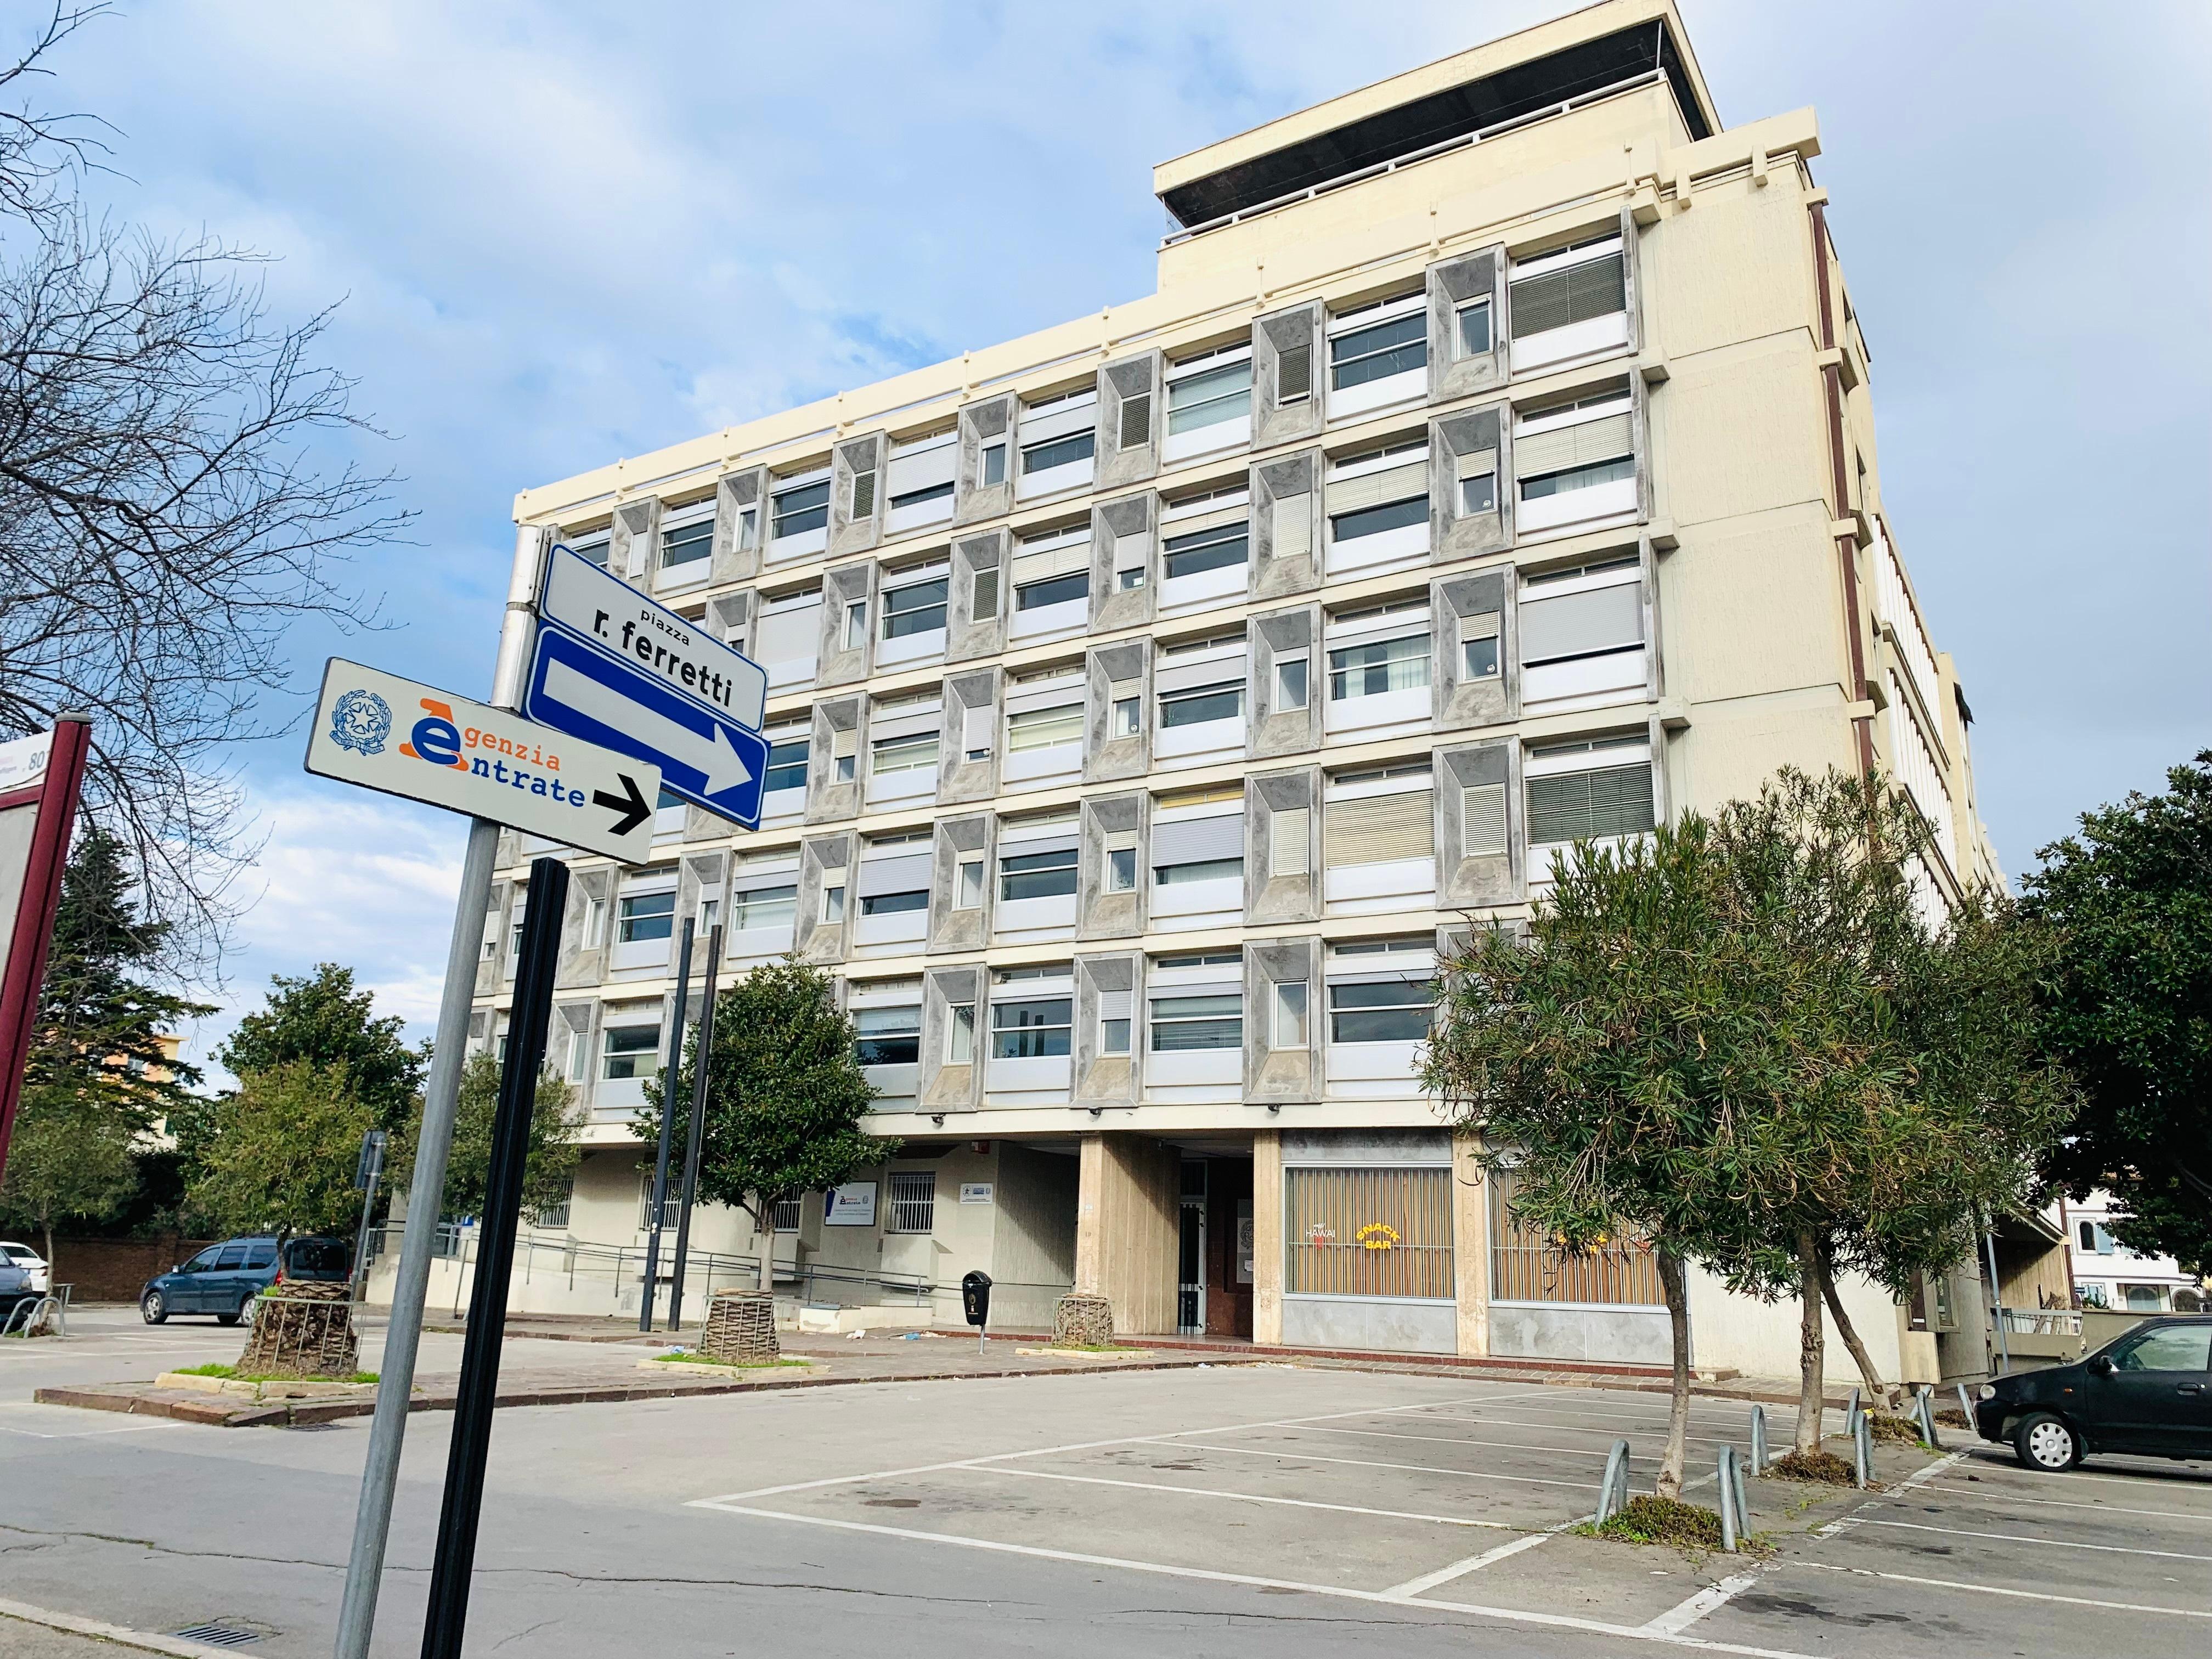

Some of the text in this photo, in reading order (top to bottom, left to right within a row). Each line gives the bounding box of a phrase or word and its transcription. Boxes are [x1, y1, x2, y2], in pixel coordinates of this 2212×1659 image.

[640, 610, 690, 646] piazza
[594, 608, 732, 707] r. ferretti
[1305, 1229, 1335, 1238] HAWAI
[1356, 1222, 1401, 1243] SNACK
[1365, 1240, 1392, 1250] BAR
